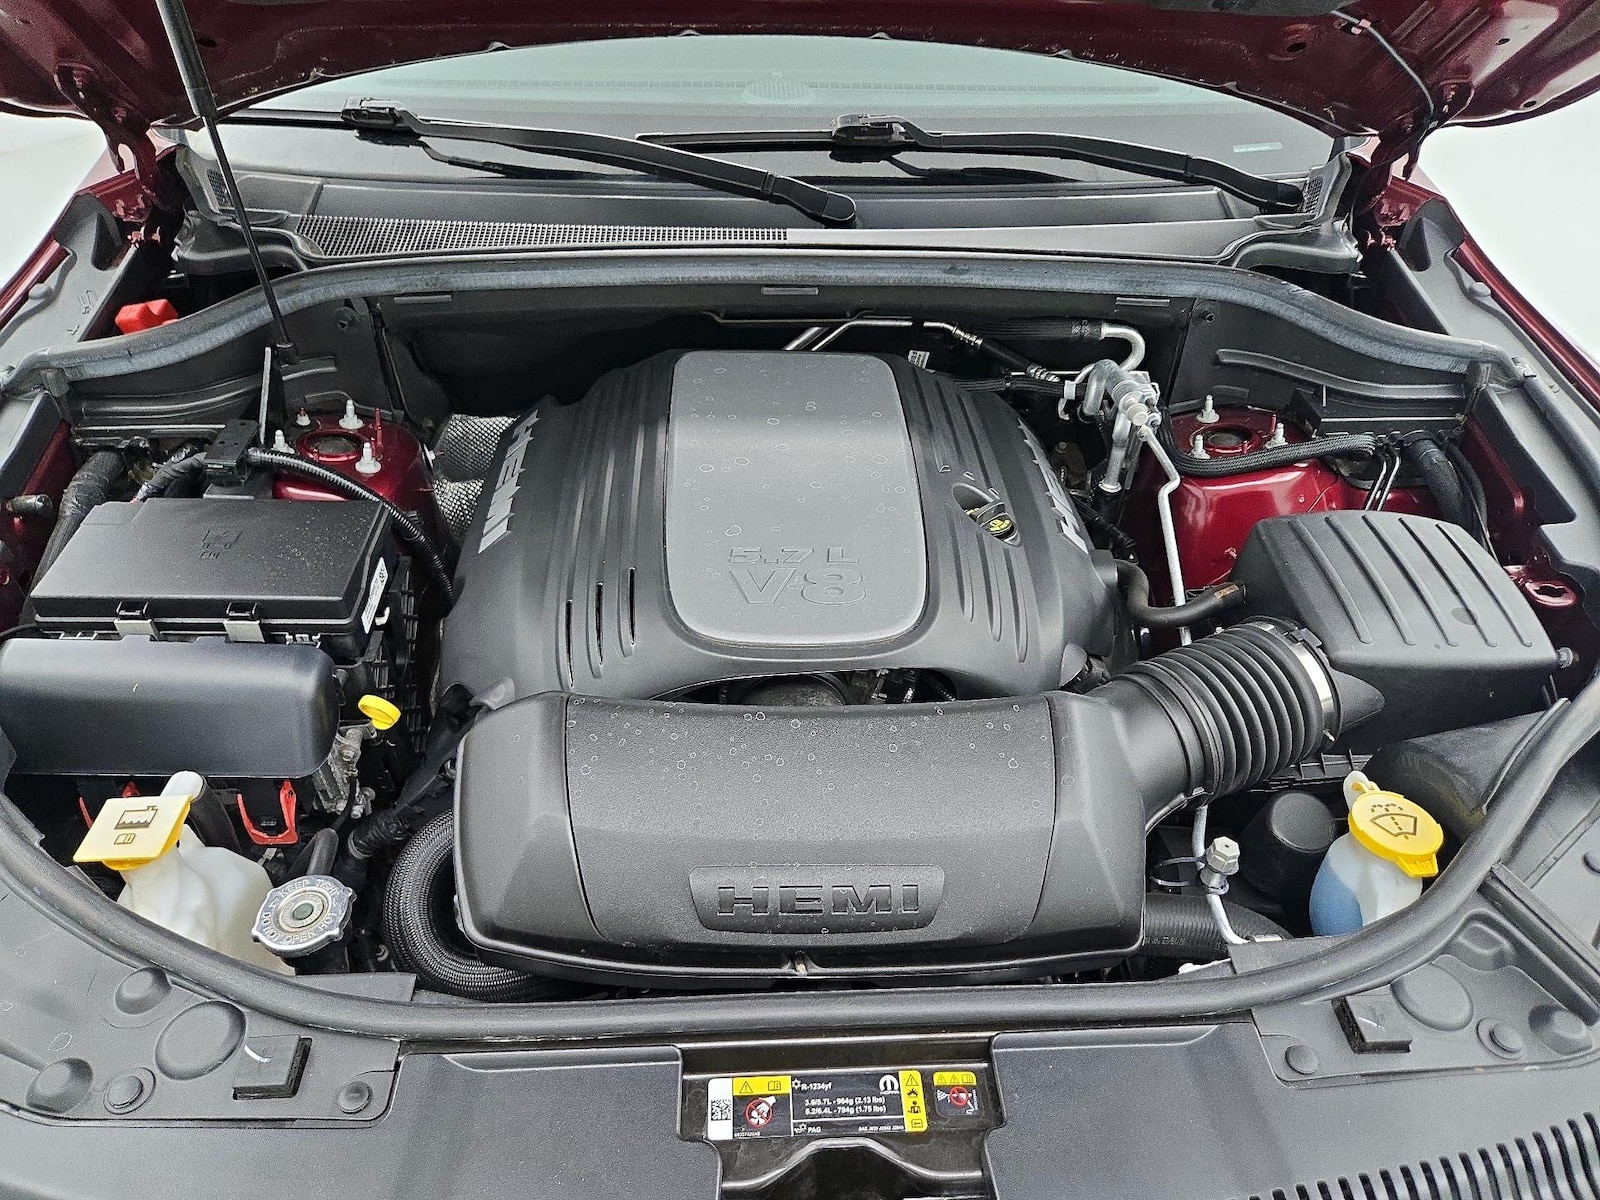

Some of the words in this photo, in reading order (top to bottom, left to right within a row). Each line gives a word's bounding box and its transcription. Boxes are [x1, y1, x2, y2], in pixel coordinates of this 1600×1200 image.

[478, 408, 540, 554] HEMI
[729, 547, 815, 564] 5.7
[827, 547, 860, 564] L
[729, 567, 867, 605] V8
[280, 880, 310, 897] KEEP
[717, 884, 919, 916] HEMI
[262, 912, 271, 924] DO
[318, 912, 338, 931] HOT
[263, 925, 282, 941] NOT
[285, 931, 316, 944] OPEN
[801, 1081, 832, 1092] R-1234yf
[855, 1096, 871, 1105] (2.13
[872, 1096, 885, 1104] lbs)
[856, 1106, 872, 1114] (1.75
[873, 1105, 886, 1113] lbs)
